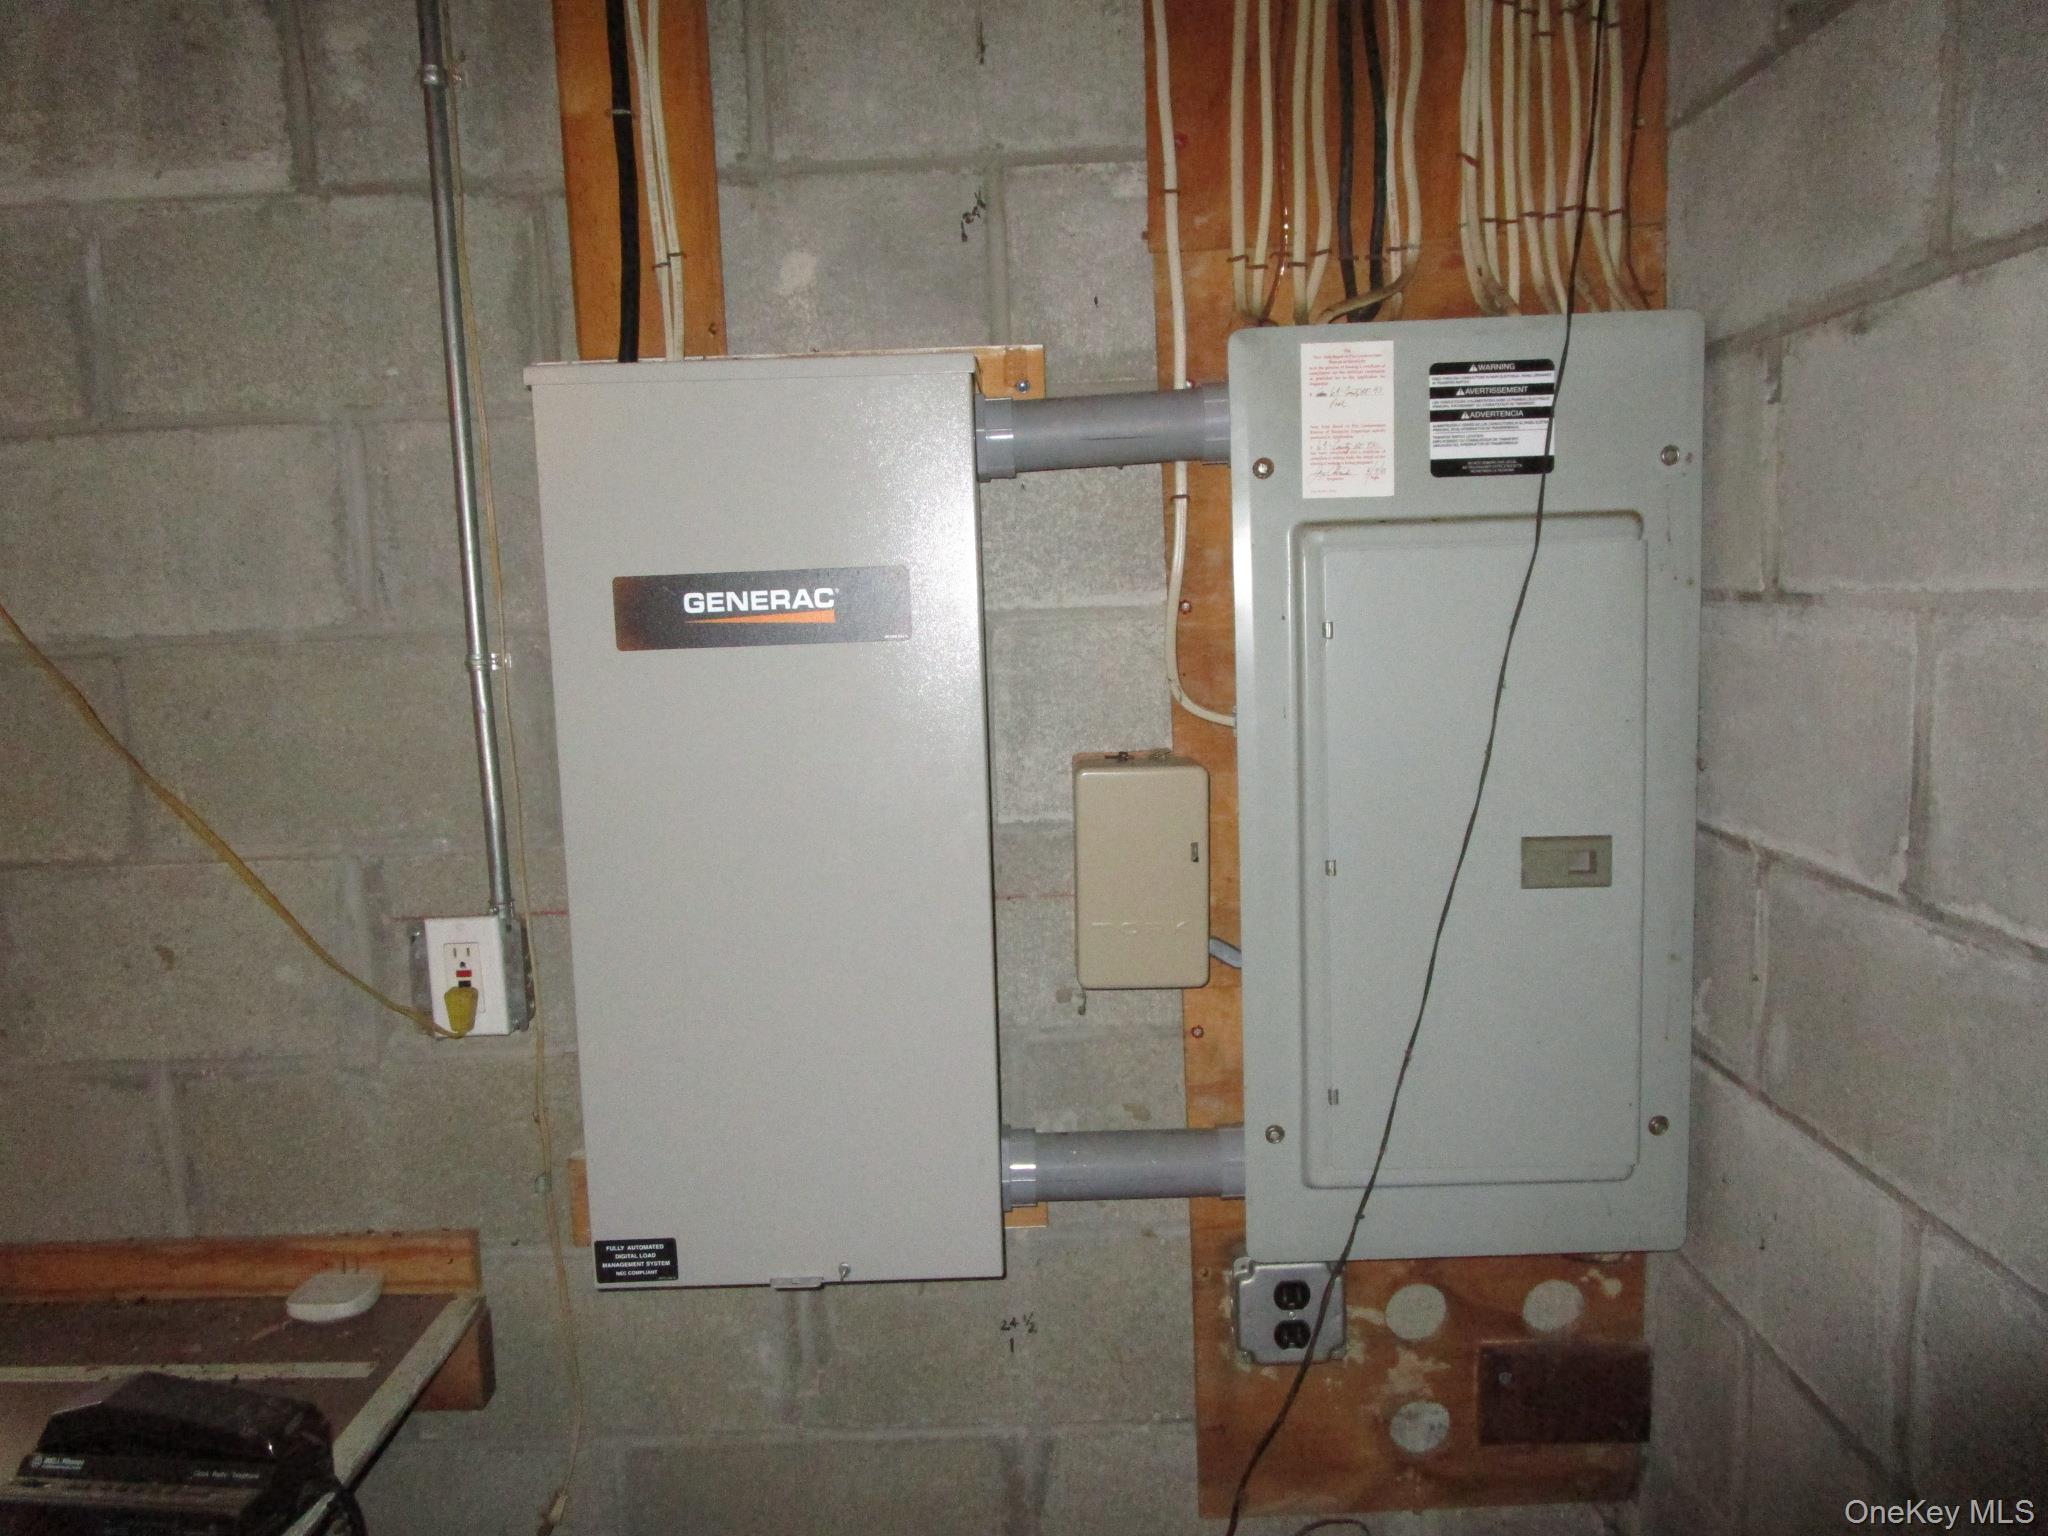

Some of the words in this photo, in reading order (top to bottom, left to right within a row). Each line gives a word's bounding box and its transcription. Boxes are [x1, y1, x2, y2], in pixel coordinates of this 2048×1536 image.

[1477, 363, 1515, 371] WARNING
[1465, 386, 1528, 395] AVERTISSEMENT
[1469, 410, 1524, 419] ADVERTENCIA
[683, 587, 835, 614] GENERAC
[627, 1243, 664, 1251] AUTOMATED
